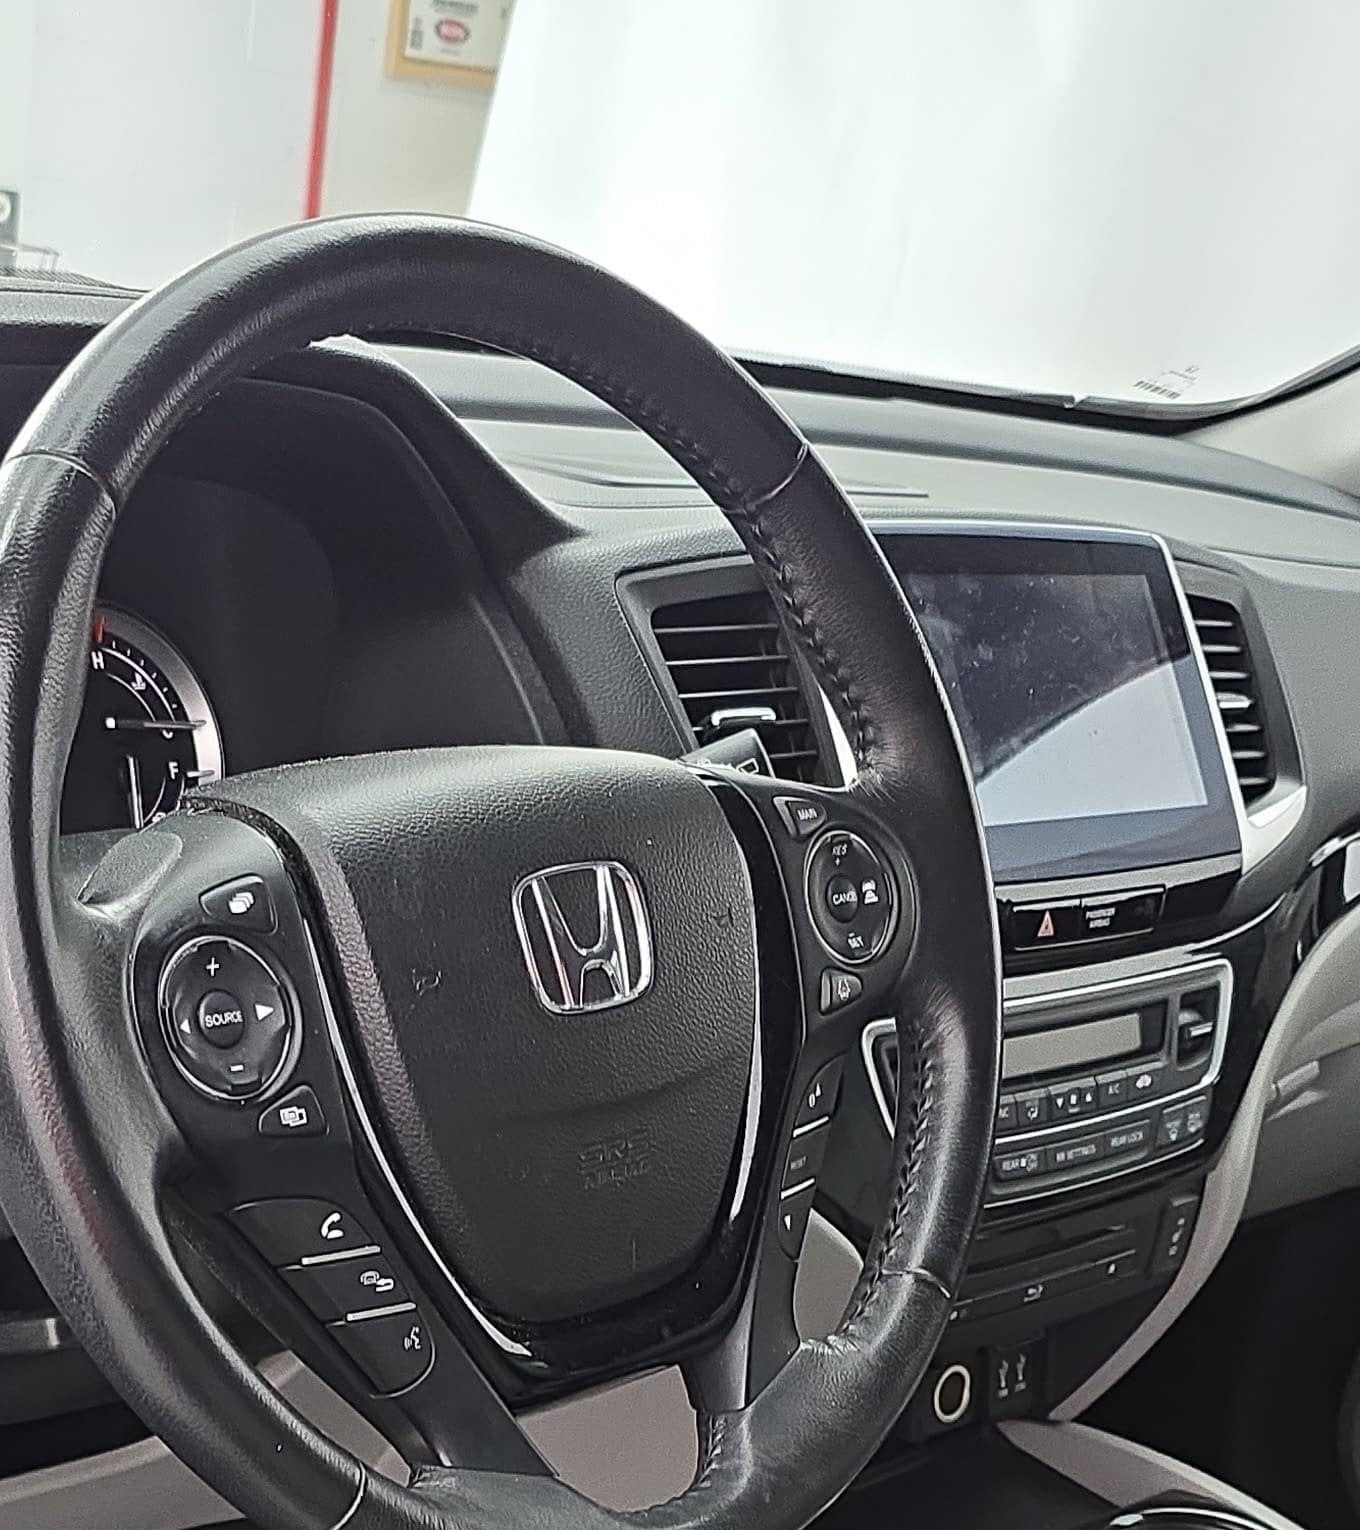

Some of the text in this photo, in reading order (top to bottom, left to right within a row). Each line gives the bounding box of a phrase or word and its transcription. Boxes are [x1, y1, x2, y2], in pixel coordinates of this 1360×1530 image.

[91, 652, 104, 669] H
[168, 761, 179, 779] F
[797, 808, 817, 821] MAIN
[205, 1009, 244, 1028] SOURCE
